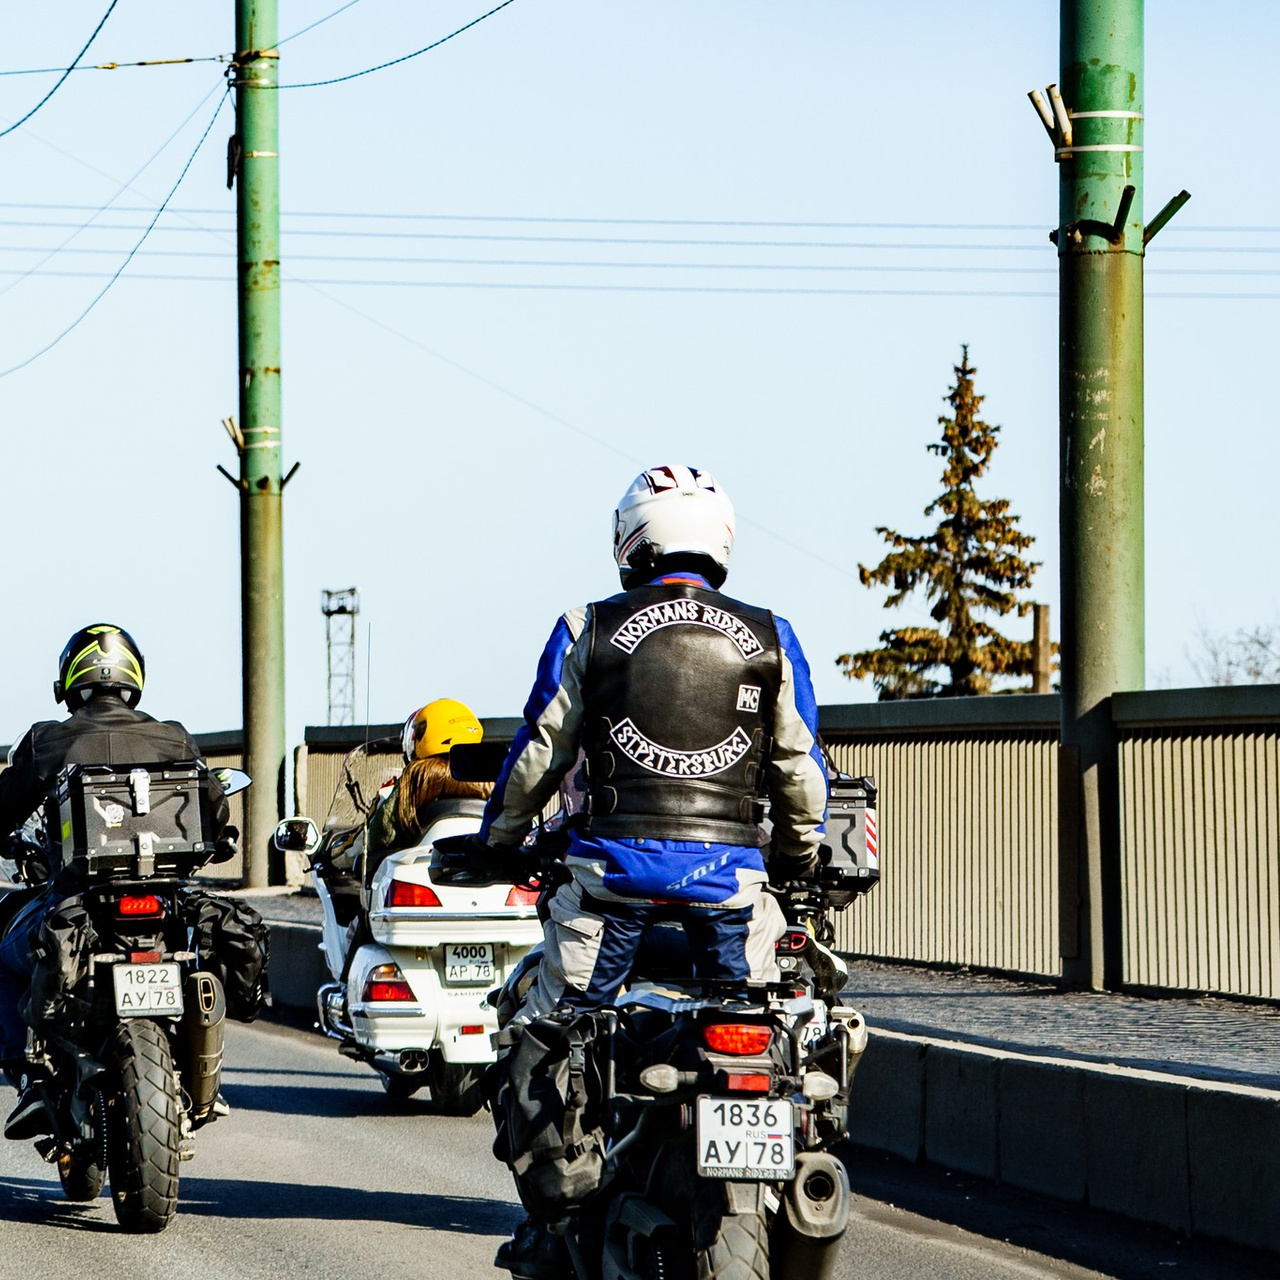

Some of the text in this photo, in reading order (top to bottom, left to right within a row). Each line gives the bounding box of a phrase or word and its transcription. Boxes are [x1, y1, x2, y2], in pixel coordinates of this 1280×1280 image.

[617, 601, 757, 652] NORMANS RIDERS
[740, 688, 758, 708] MC
[666, 852, 730, 890] SCOTT
[452, 946, 486, 959] 4000
[125, 969, 170, 984] 1822
[475, 965, 490, 977] 78
[154, 991, 176, 1005] 78
[713, 1103, 778, 1127] 1836
[745, 1130, 767, 1139] RUS
[753, 1141, 785, 1165] 78
[706, 1168, 788, 1179] NORMANS RIDERS MC
